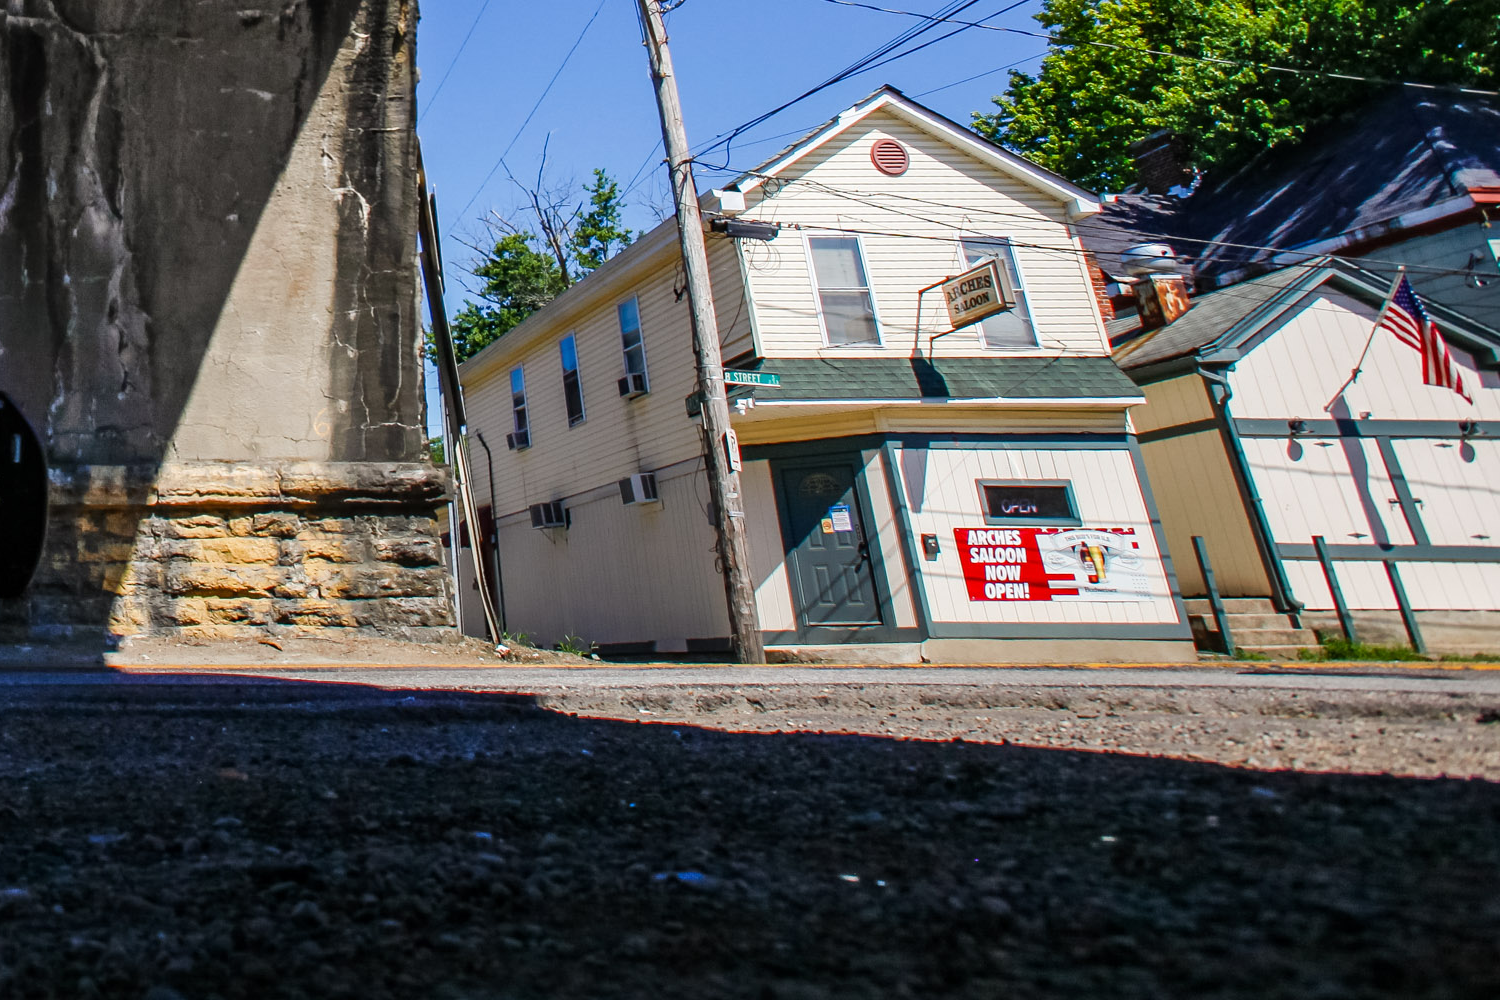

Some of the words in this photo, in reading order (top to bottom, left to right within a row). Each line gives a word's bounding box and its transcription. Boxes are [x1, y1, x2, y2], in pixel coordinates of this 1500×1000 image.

[946, 275, 992, 304] ARCHES
[954, 292, 990, 314] SALOON
[734, 373, 760, 383] STREET
[1001, 498, 1038, 513] OPEN
[968, 530, 1021, 546] ARCHES
[970, 548, 1027, 563] SALOON
[985, 565, 1020, 581] NOW
[984, 583, 1030, 599] OPEN!
